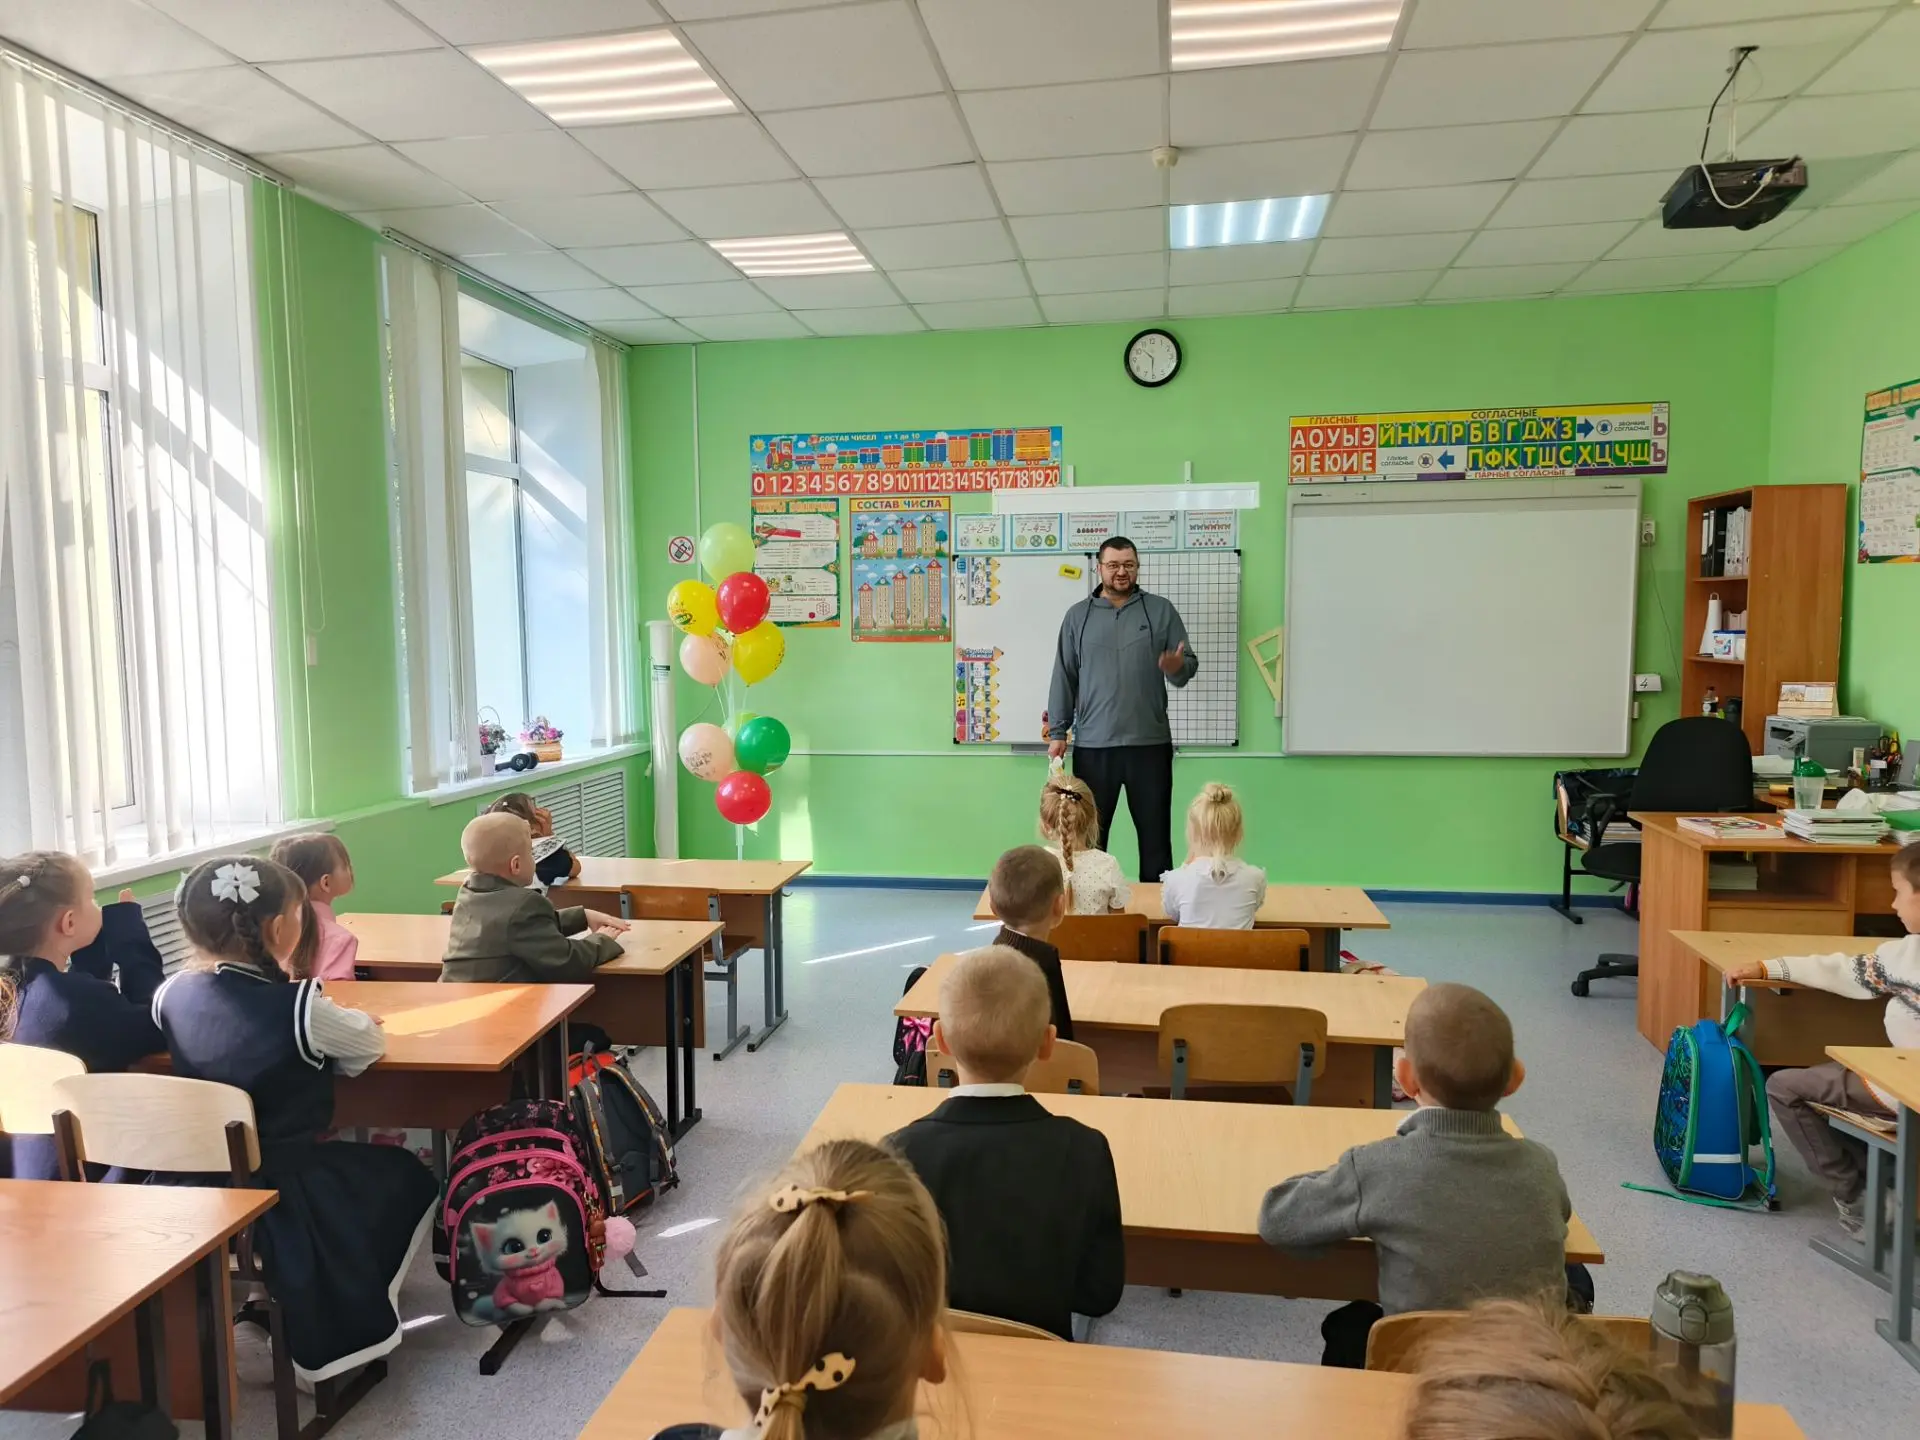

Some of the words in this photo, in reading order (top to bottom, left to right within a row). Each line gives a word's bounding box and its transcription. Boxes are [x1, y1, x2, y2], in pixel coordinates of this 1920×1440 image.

[1309, 415, 1358, 425] ГЛАСНЫЕ
[1471, 409, 1537, 420] СОГЛАСНЫЕ
[1475, 470, 1510, 478] ПАРНЫЕ
[1513, 468, 1565, 477] СОГЛАСНЫЕ
[753, 476, 765, 493] 0
[769, 476, 778, 492] 1
[782, 476, 793, 493] 2
[796, 475, 807, 492] 3
[809, 475, 822, 492] 4
[824, 475, 835, 492] 5
[838, 474, 850, 492] 6
[852, 474, 864, 492] 7
[867, 474, 879, 492] 8
[882, 473, 894, 491] 9
[896, 472, 910, 490] 10
[911, 472, 924, 490] 11
[925, 471, 940, 490] 12
[940, 471, 954, 489] 13
[955, 471, 969, 489] 14
[970, 470, 984, 489] 15
[985, 470, 999, 488] 16
[1001, 469, 1014, 488] 17
[1015, 469, 1029, 488] 18
[1030, 469, 1044, 488] 19
[1045, 468, 1059, 487] 20
[857, 500, 899, 510] СОСТАВ
[903, 499, 942, 508] ЧИСЛА
[1640, 676, 1648, 689] 4
